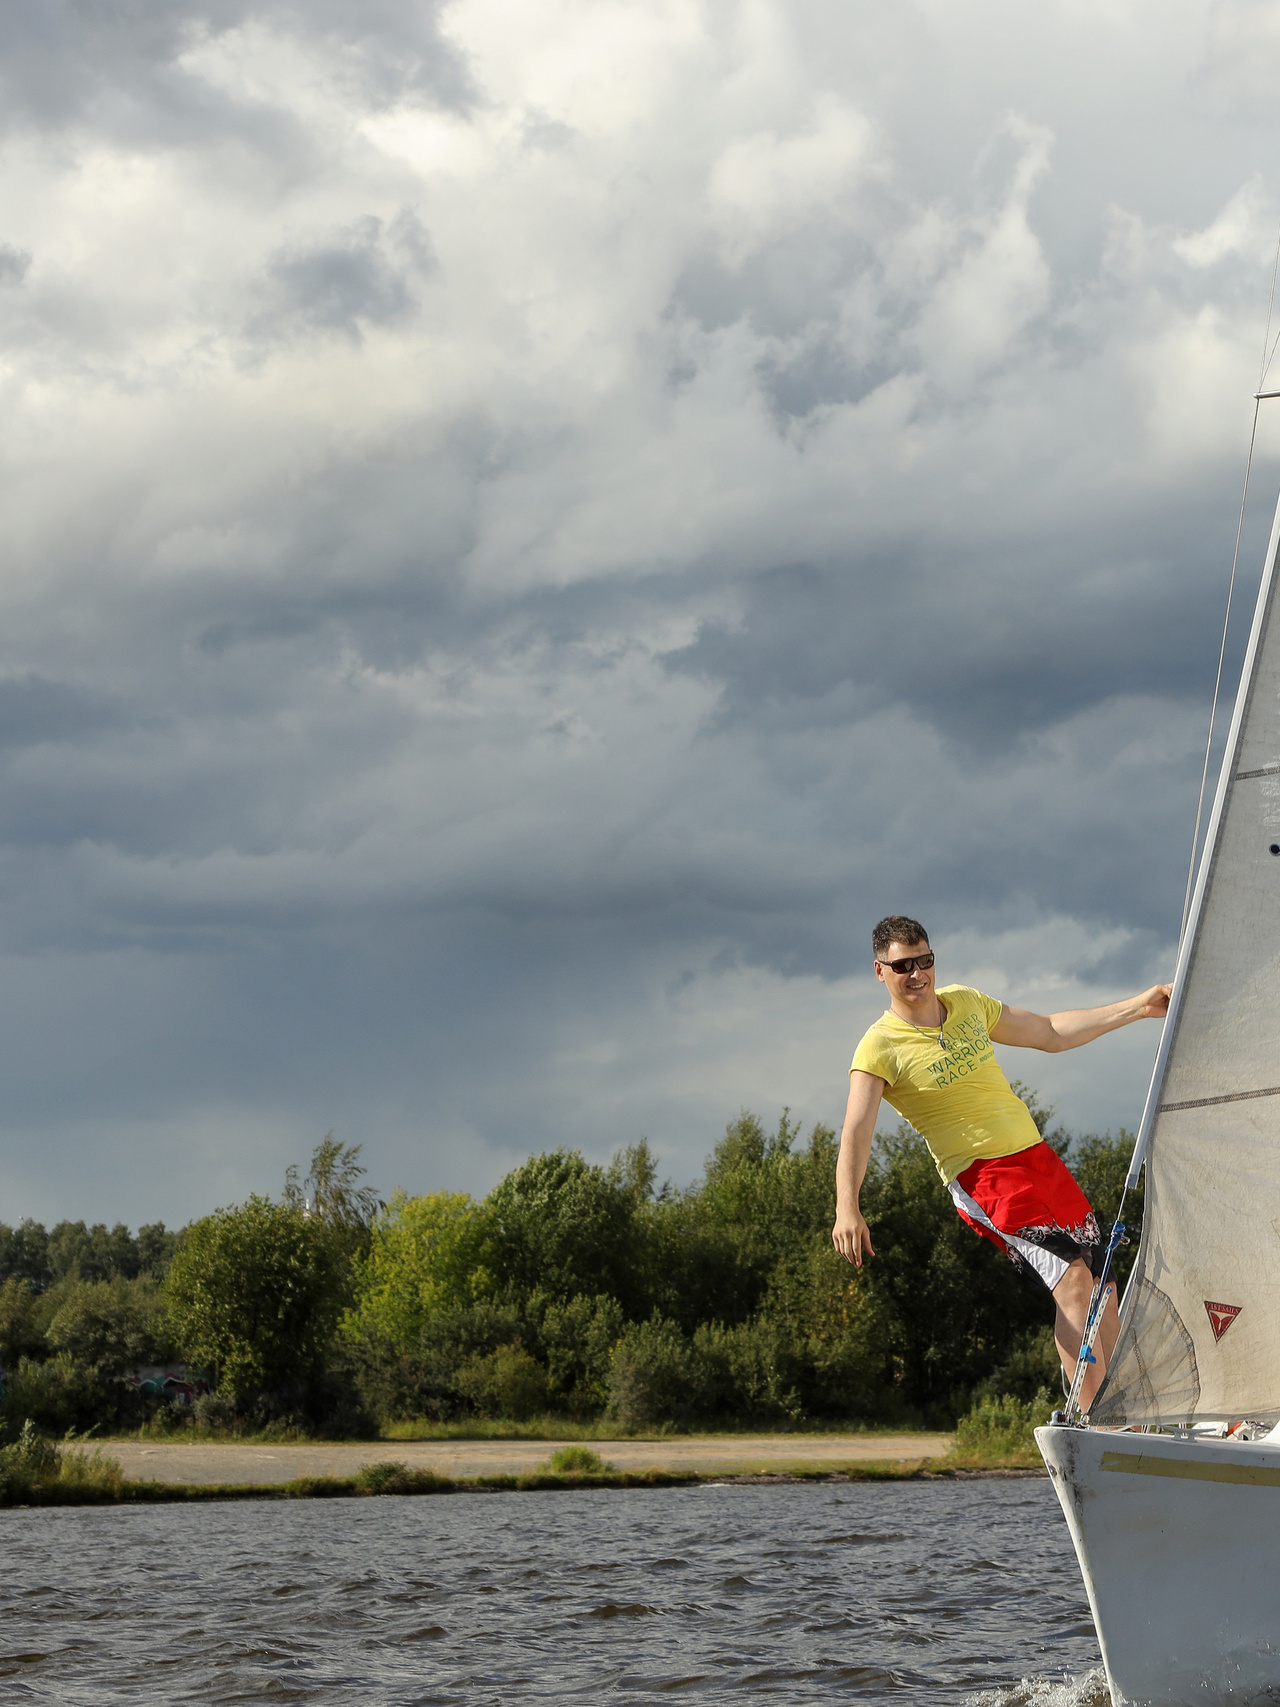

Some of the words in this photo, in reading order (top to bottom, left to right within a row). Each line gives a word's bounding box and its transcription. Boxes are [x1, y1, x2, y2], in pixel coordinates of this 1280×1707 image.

[942, 1013, 983, 1045] SUPER
[946, 1035, 973, 1052] REAL
[935, 1059, 978, 1090] RACE
